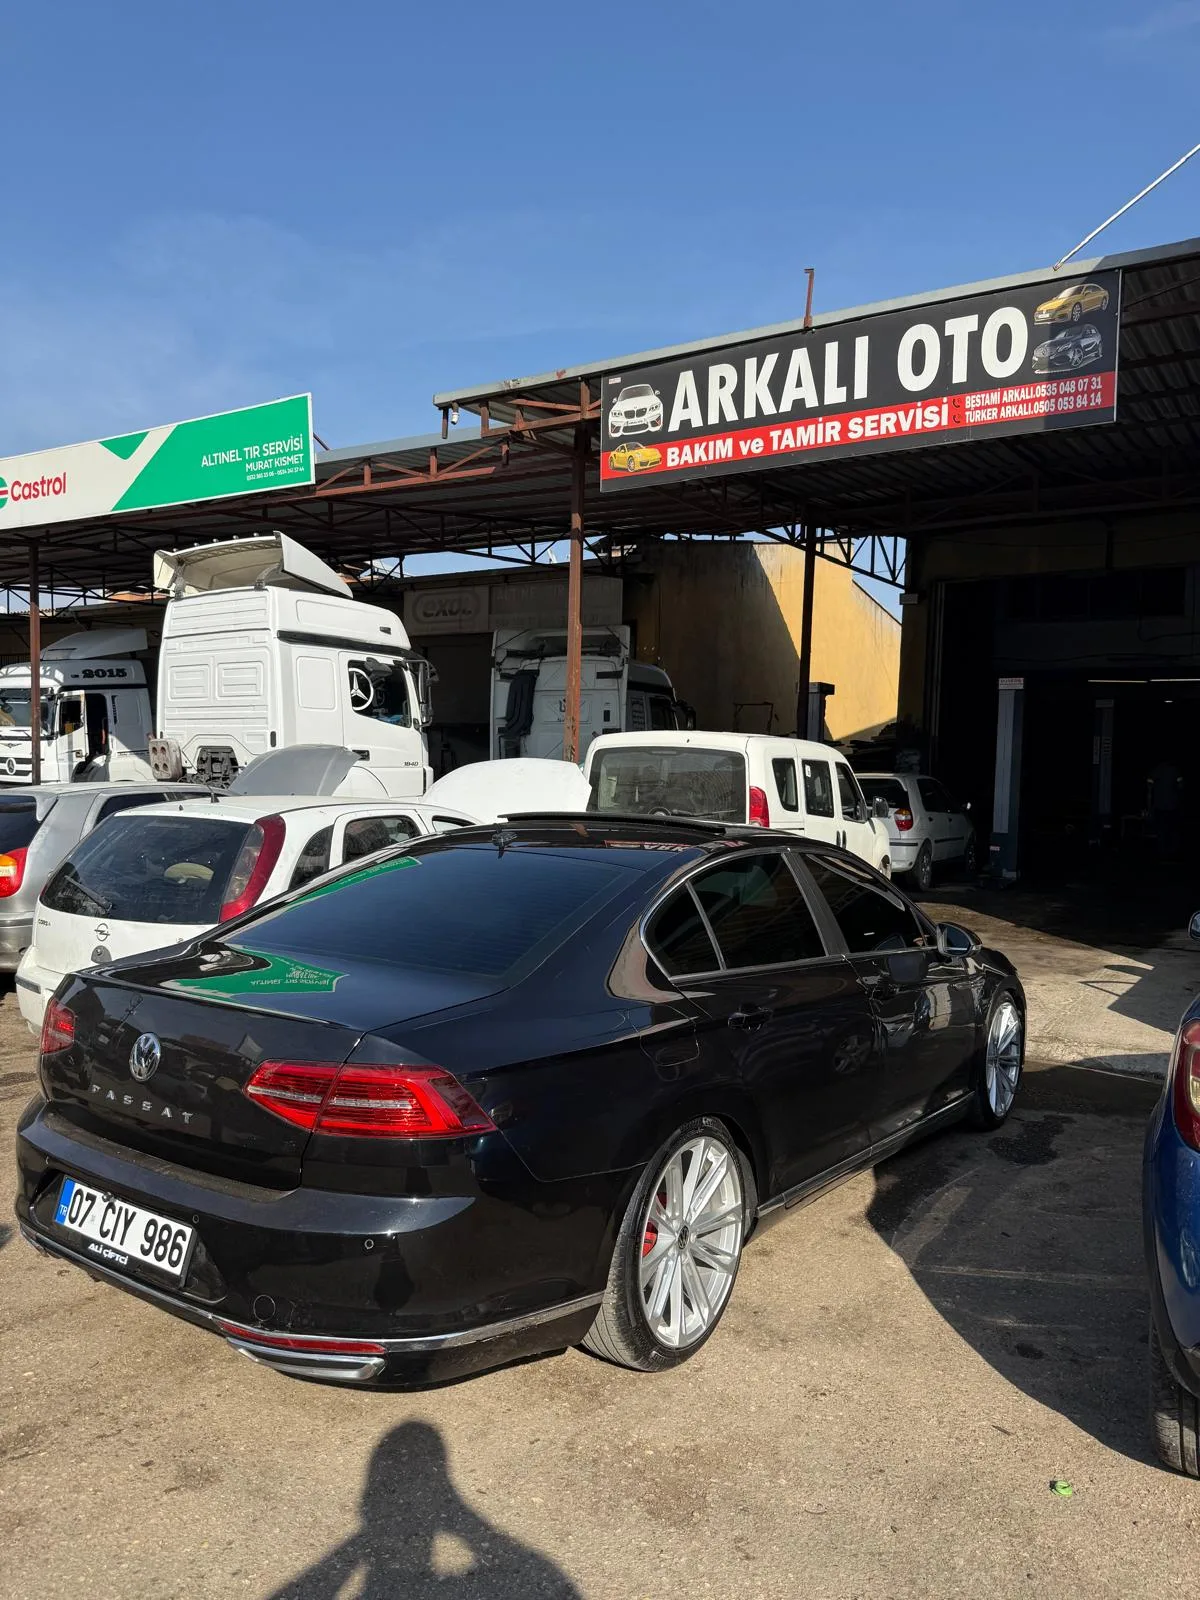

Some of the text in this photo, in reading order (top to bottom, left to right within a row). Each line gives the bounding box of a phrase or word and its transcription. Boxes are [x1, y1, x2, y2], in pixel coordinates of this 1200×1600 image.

[667, 306, 1029, 433] ARKALI OTO
[965, 388, 1001, 409] BESTAMİ
[1059, 380, 1076, 394] 048
[1077, 378, 1089, 392] 07
[1090, 376, 1103, 390] 31
[965, 406, 998, 424] TÜRKER
[1057, 396, 1074, 411] 053
[1076, 394, 1088, 408] 84
[1089, 391, 1102, 406] 14
[666, 397, 949, 468] BAKIM ve TAMİR SERVİSİ
[201, 433, 304, 468] ALTINEL TIR SERVİSİ
[245, 453, 305, 473] MURAT KISMET
[10, 471, 67, 502] Castrol
[82, 668, 128, 679] 2015
[90, 1084, 194, 1125] PASSAT
[59, 1204, 68, 1217] TR
[68, 1188, 187, 1268] 07 CIY 986
[88, 1243, 104, 1255] ALİ
